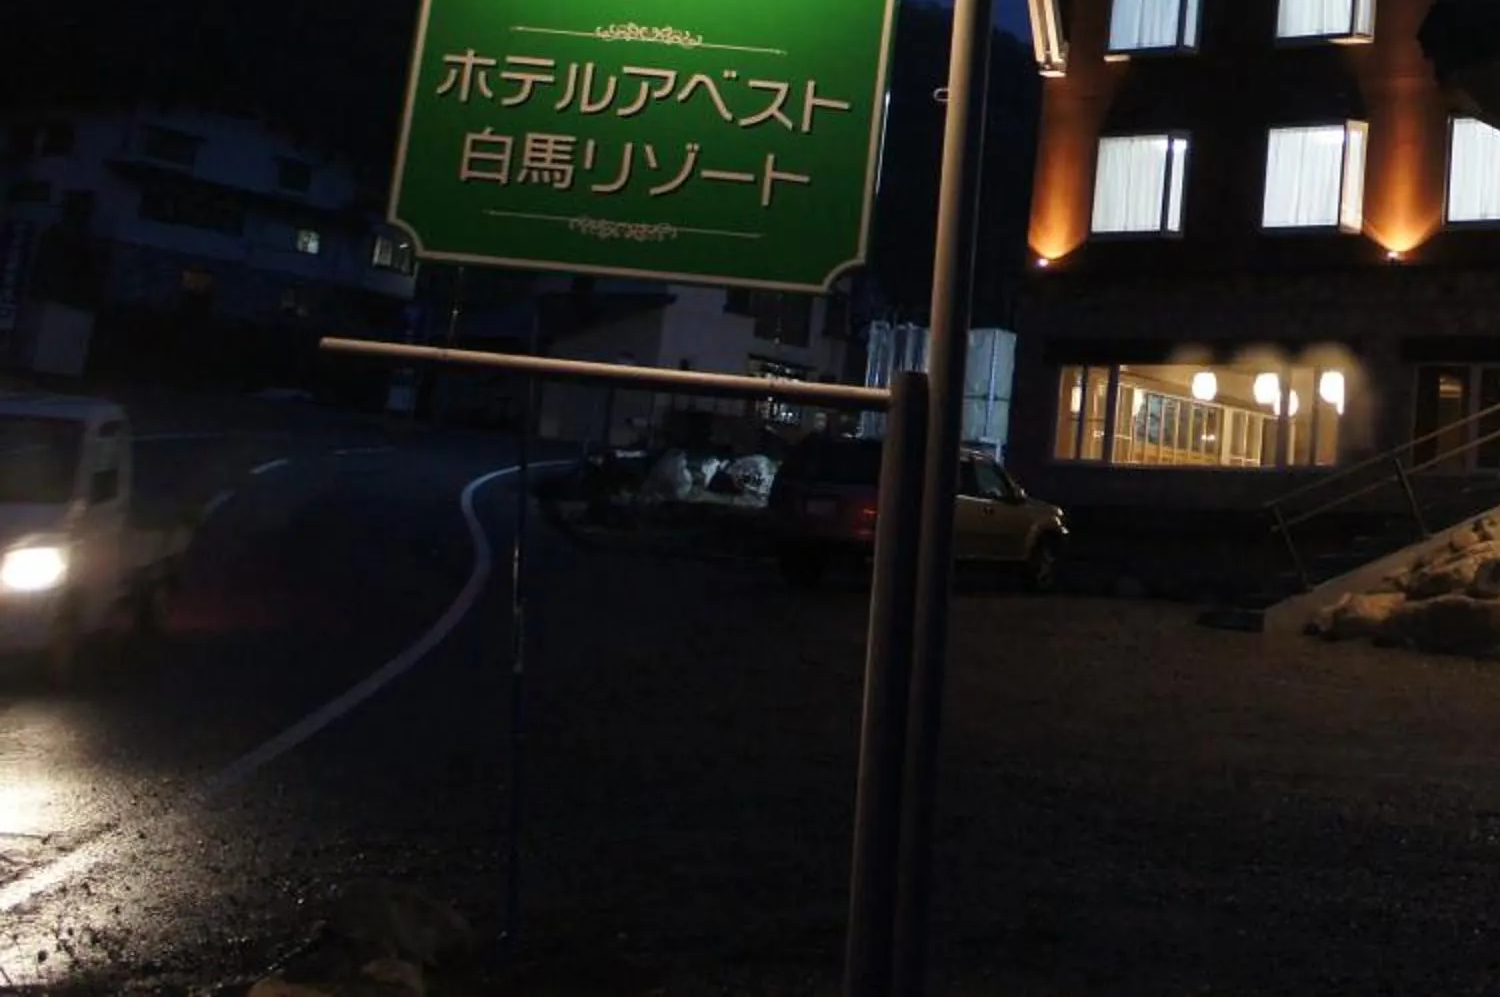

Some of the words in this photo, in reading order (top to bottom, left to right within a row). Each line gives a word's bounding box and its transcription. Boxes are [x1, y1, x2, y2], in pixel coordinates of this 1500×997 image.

[435, 49, 851, 133] ホテルアベスト
[458, 127, 810, 207] 白馬リゾート
